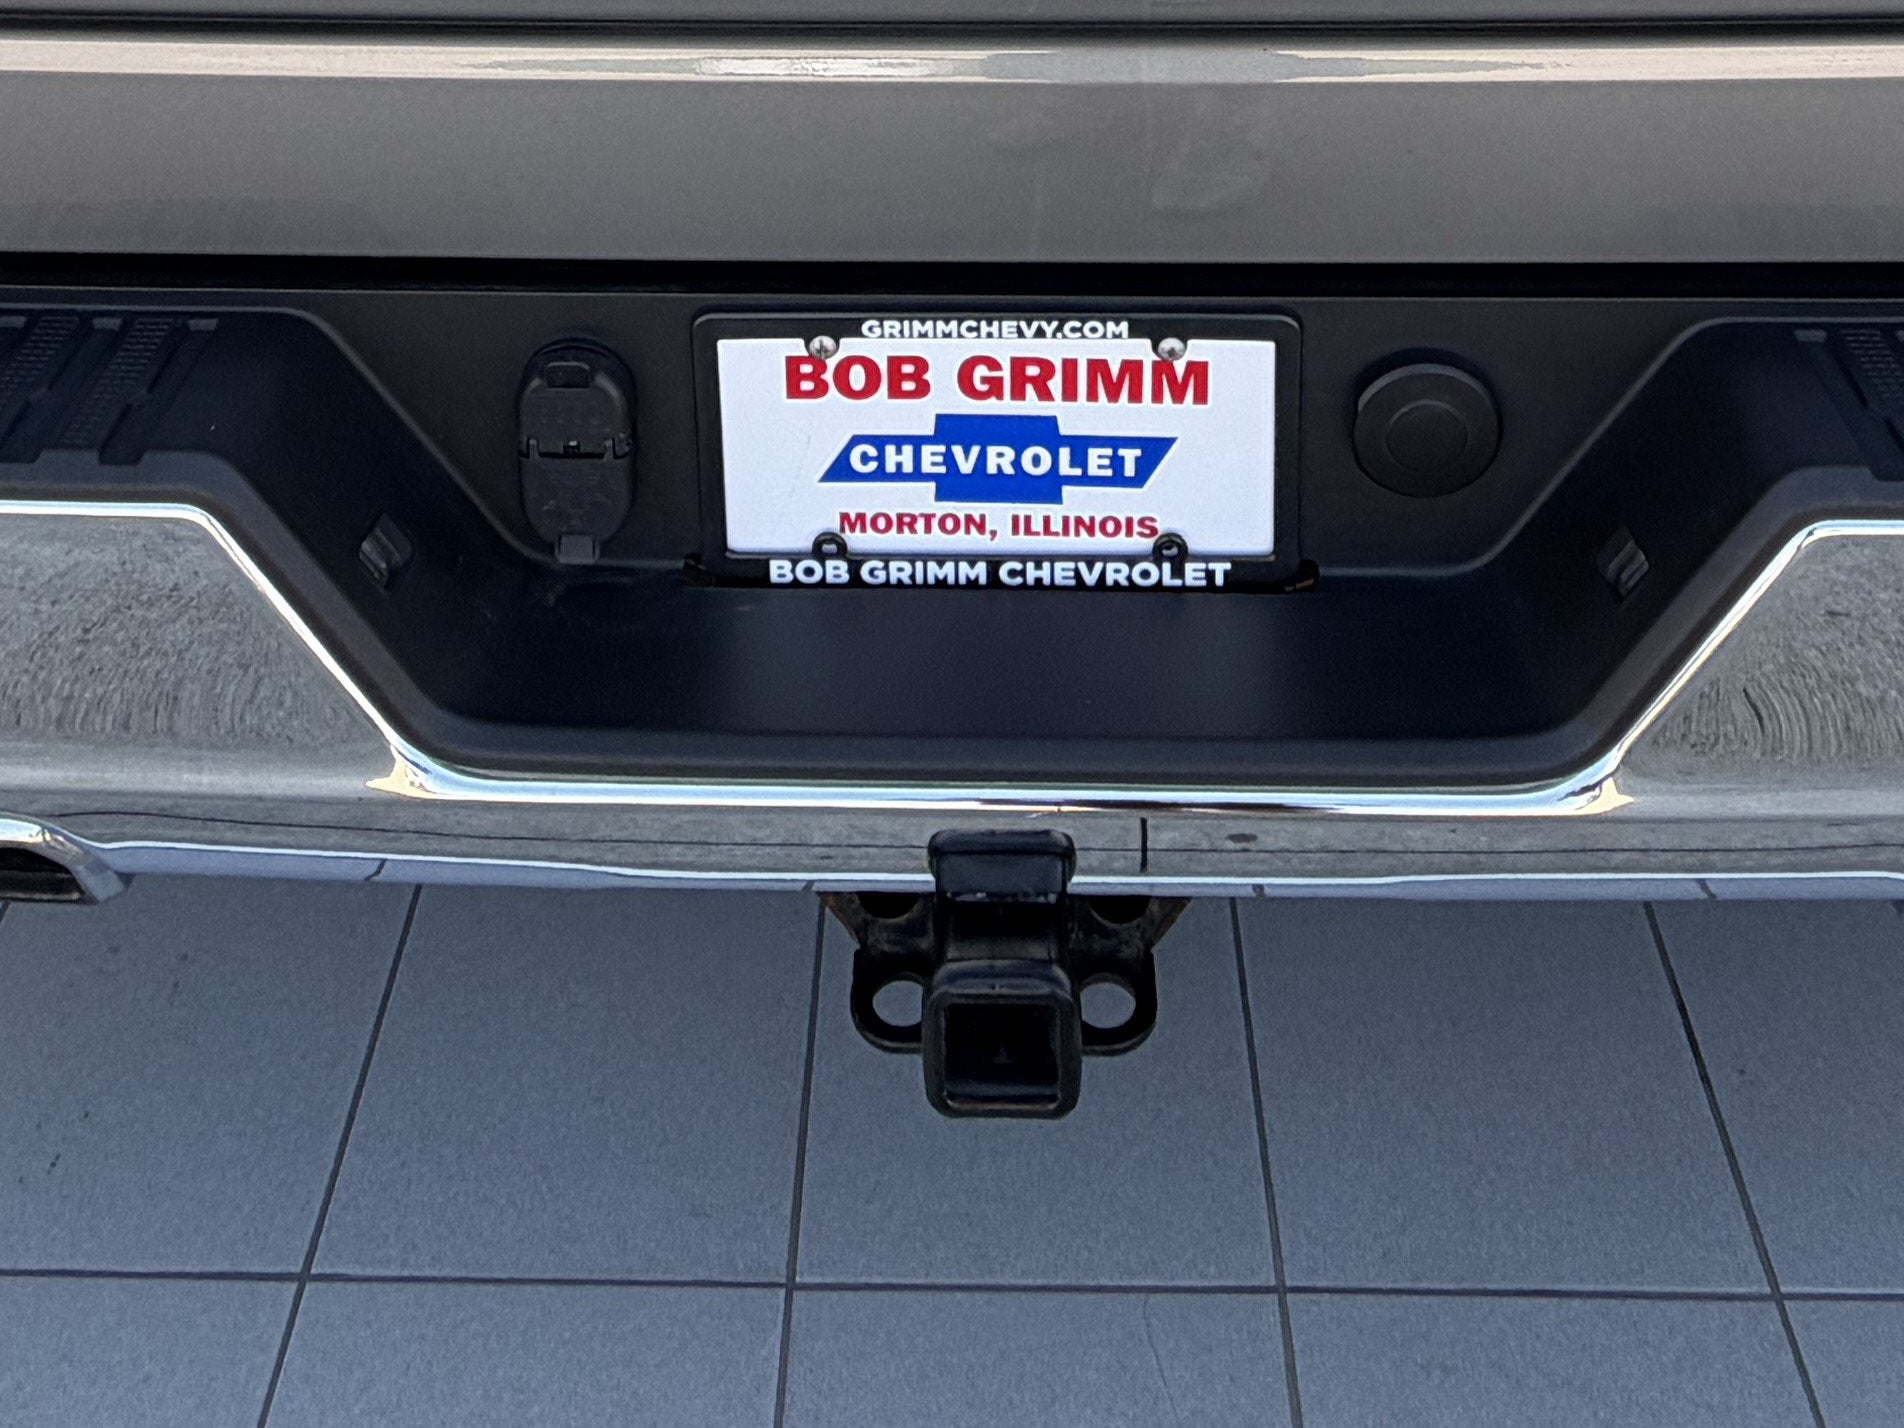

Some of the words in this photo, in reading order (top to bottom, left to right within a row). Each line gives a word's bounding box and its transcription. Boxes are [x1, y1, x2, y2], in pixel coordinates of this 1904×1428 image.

[860, 319, 1130, 340] GRIMMCHEVY.COM
[784, 354, 932, 401] BOB
[956, 356, 1210, 406] GRIMM
[848, 442, 1142, 478] CHEVROLET
[838, 511, 998, 542] MORTON,
[1010, 514, 1160, 540] ILLINOIS
[769, 559, 850, 586] BOB
[859, 560, 988, 587] GRIMM
[998, 560, 1232, 588] CHEVROLET
